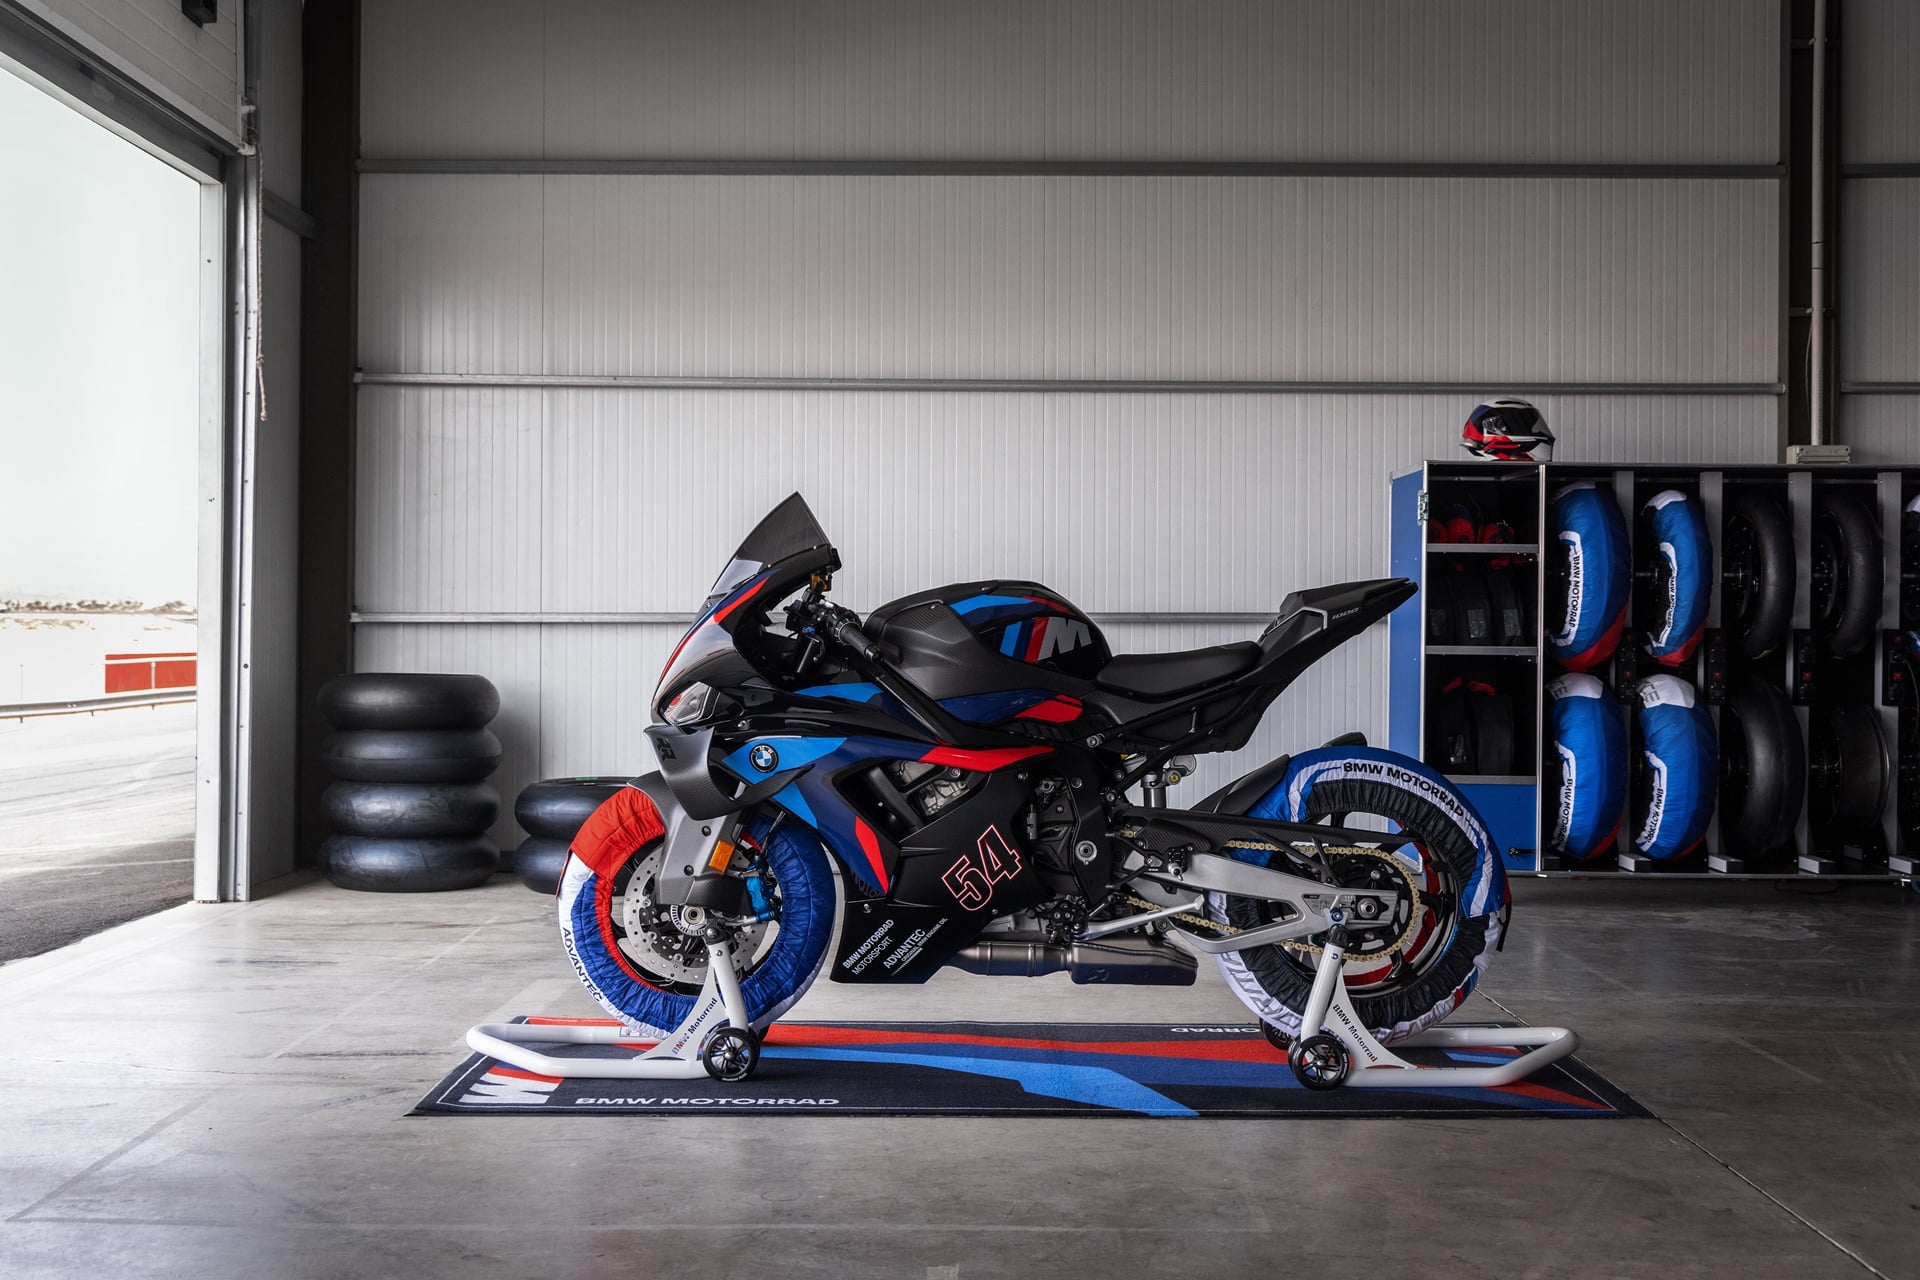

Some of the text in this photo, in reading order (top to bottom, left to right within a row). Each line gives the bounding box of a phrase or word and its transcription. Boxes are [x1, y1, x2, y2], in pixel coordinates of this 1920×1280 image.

[1568, 555, 1580, 628] BMW MOTORRAD
[1343, 762, 1464, 817] BMW MOTORRAD
[941, 824, 1023, 911] 54
[562, 927, 603, 1002] ADVANTEC
[842, 919, 894, 969] BMW MOTORRAD
[851, 936, 893, 975] MOTORSPORT
[883, 929, 926, 969] ADVANTEC
[671, 997, 718, 1055] BMW Motorrad
[1332, 1004, 1378, 1063] BMW Motorrad
